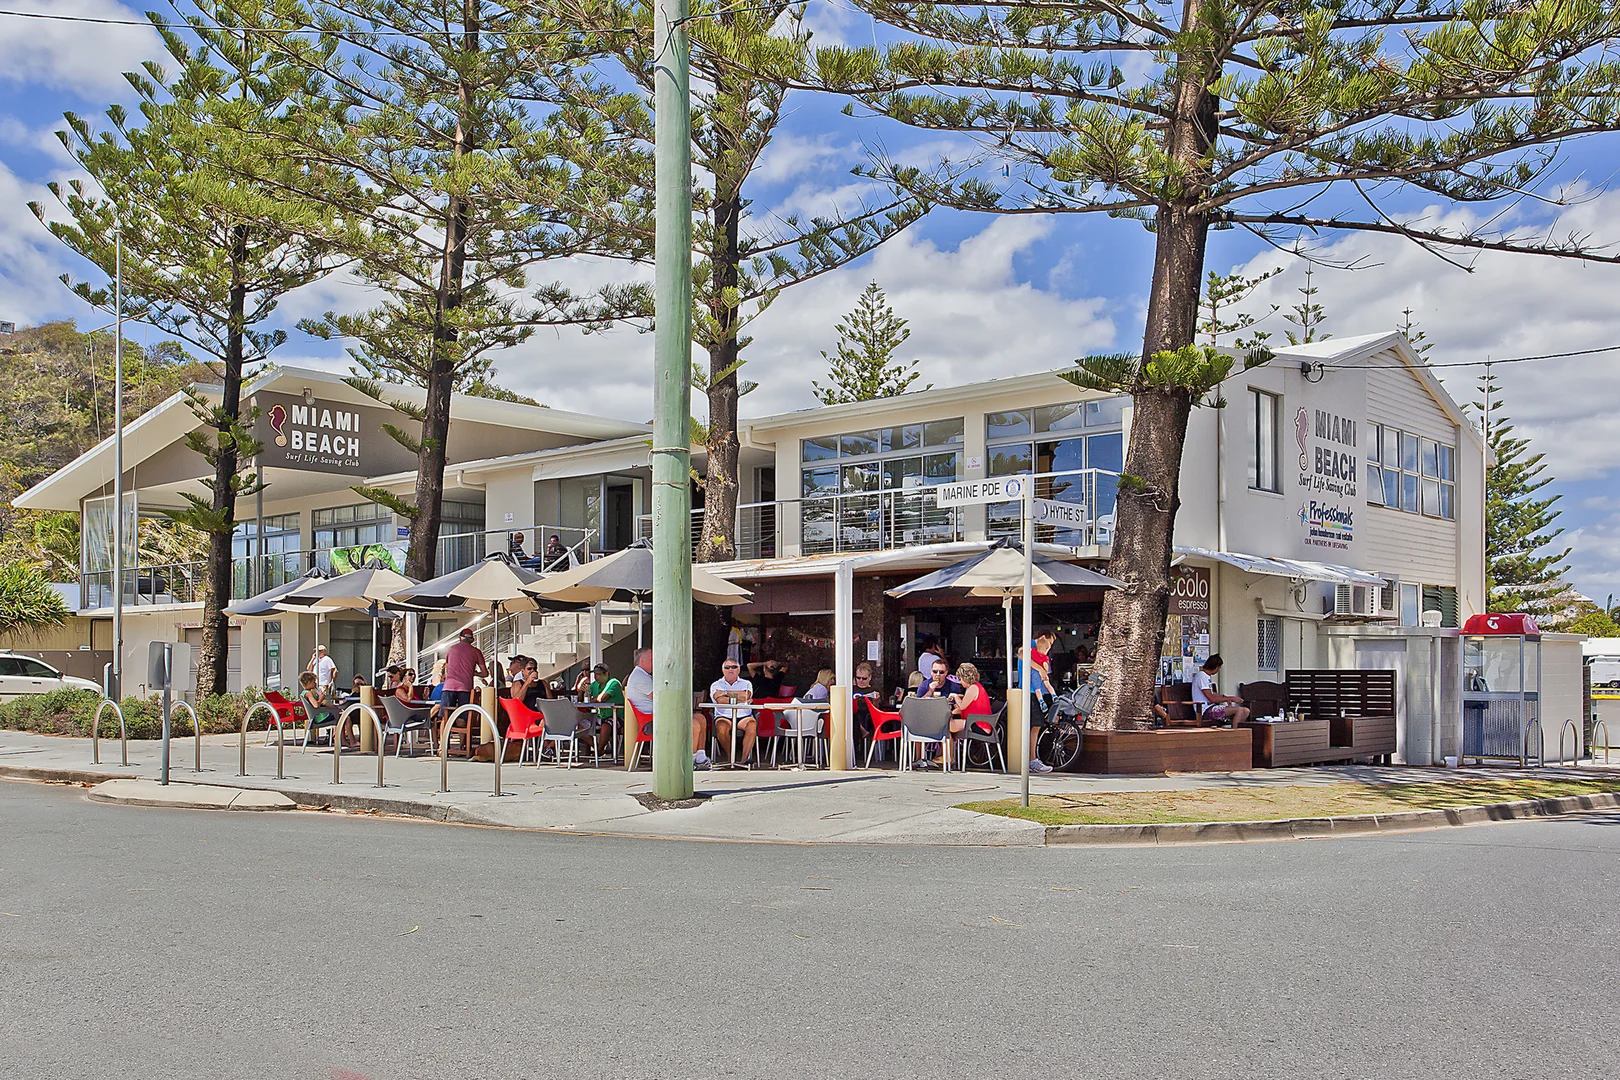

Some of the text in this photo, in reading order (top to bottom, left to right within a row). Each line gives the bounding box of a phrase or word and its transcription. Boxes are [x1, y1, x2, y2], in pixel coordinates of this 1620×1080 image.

[291, 404, 360, 433] MIAMI
[1315, 409, 1357, 447] MIAMI
[291, 430, 360, 458] BEACH
[285, 452, 360, 467] Surf Life Saving Club
[1315, 446, 1357, 482] BEACH
[942, 484, 978, 501] MARINE
[982, 482, 1001, 497] PDE
[1299, 473, 1357, 498] Surf Life Saving Club
[1049, 504, 1085, 522] HYTHE ST
[1310, 500, 1353, 528] Professionals
[1178, 599, 1209, 612] espresso
